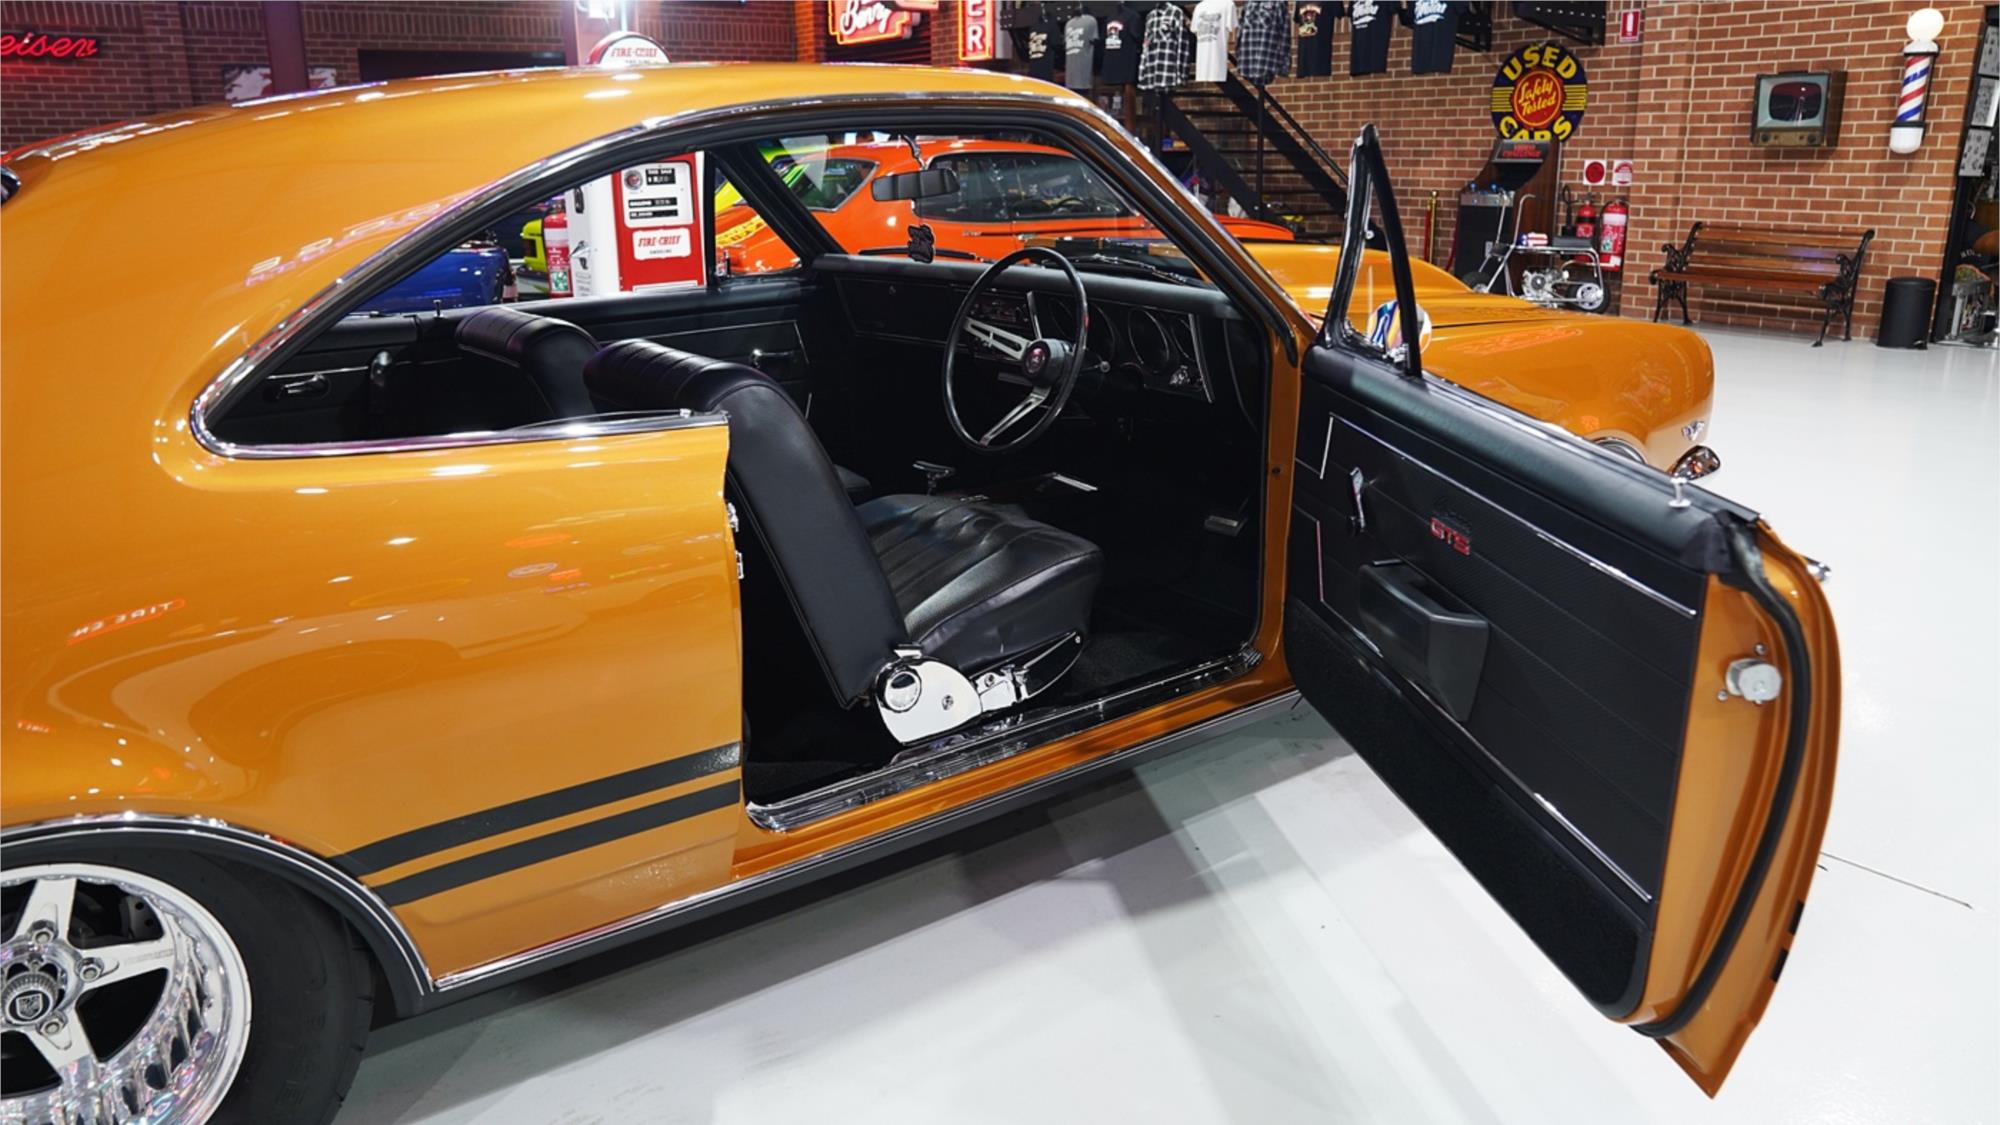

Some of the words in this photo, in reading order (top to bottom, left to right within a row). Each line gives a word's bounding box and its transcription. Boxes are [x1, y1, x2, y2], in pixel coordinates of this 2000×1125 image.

[1503, 46, 1577, 80] USED
[1518, 79, 1554, 103] Safety
[1521, 92, 1556, 116] Tested
[1430, 517, 1470, 555] GTS
